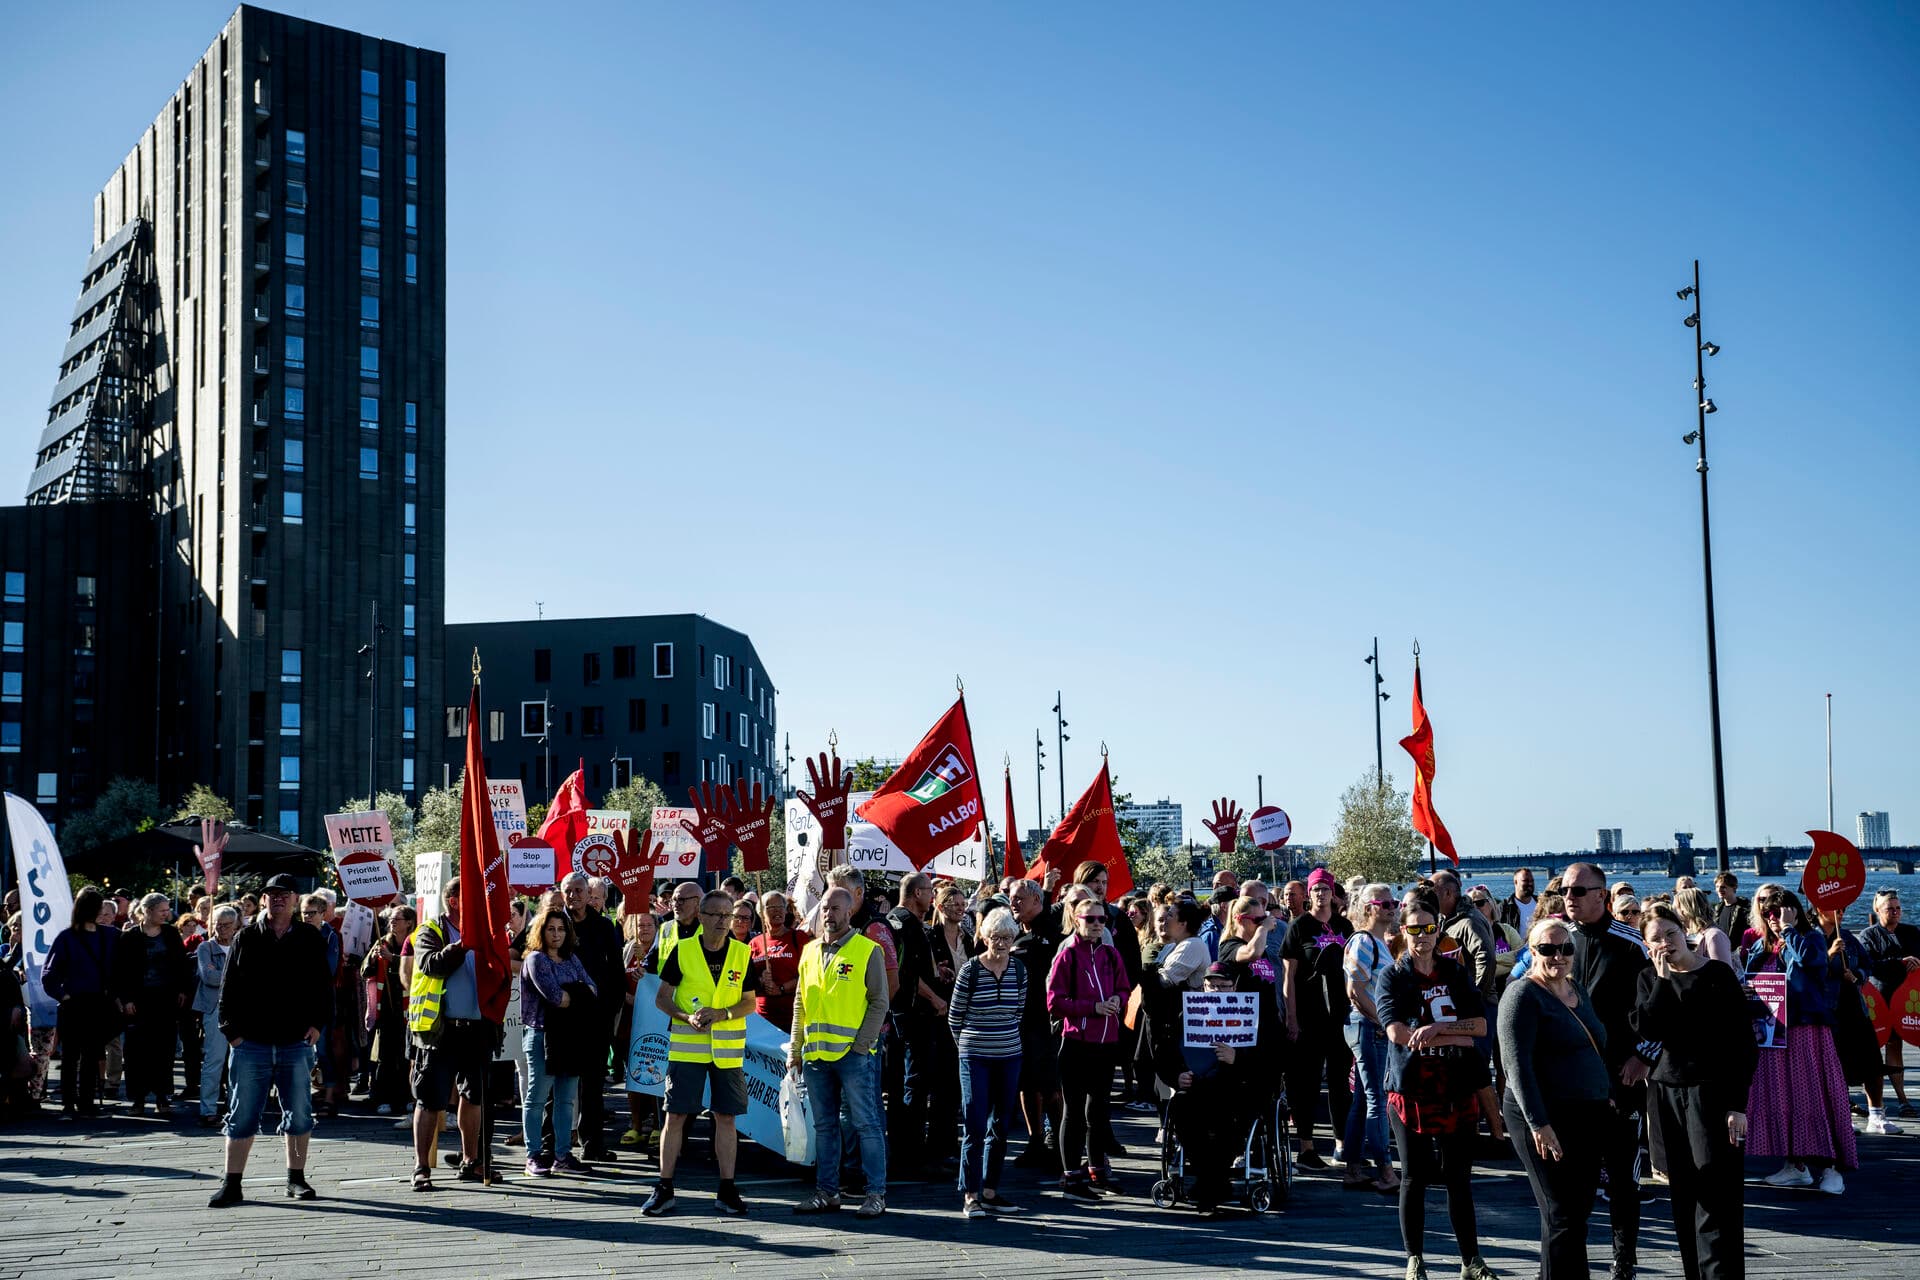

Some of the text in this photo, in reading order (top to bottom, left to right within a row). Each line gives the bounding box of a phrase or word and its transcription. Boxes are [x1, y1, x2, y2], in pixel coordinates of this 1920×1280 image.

[491, 799, 510, 807] VER
[818, 796, 844, 810] VELFÆRD
[656, 810, 683, 819] STØT
[820, 808, 834, 818] IGEN
[496, 821, 525, 830] TELSER
[602, 818, 627, 829] UGER
[736, 819, 765, 834] VELFÆRD
[339, 826, 383, 844] METTE
[702, 826, 716, 836] VELF
[739, 832, 755, 842] IGEN
[523, 852, 540, 860] Stop
[682, 854, 694, 862] SF
[851, 845, 889, 866] orvej
[620, 864, 650, 879] VELFÆRD
[347, 876, 388, 886] velfærden
[622, 877, 638, 886] IGEN
[1817, 881, 1840, 894] dbio
[837, 963, 853, 975] 3F
[728, 969, 742, 982] 3F
[643, 1037, 668, 1047] BEVAR
[640, 1045, 667, 1054] SENIOR-
